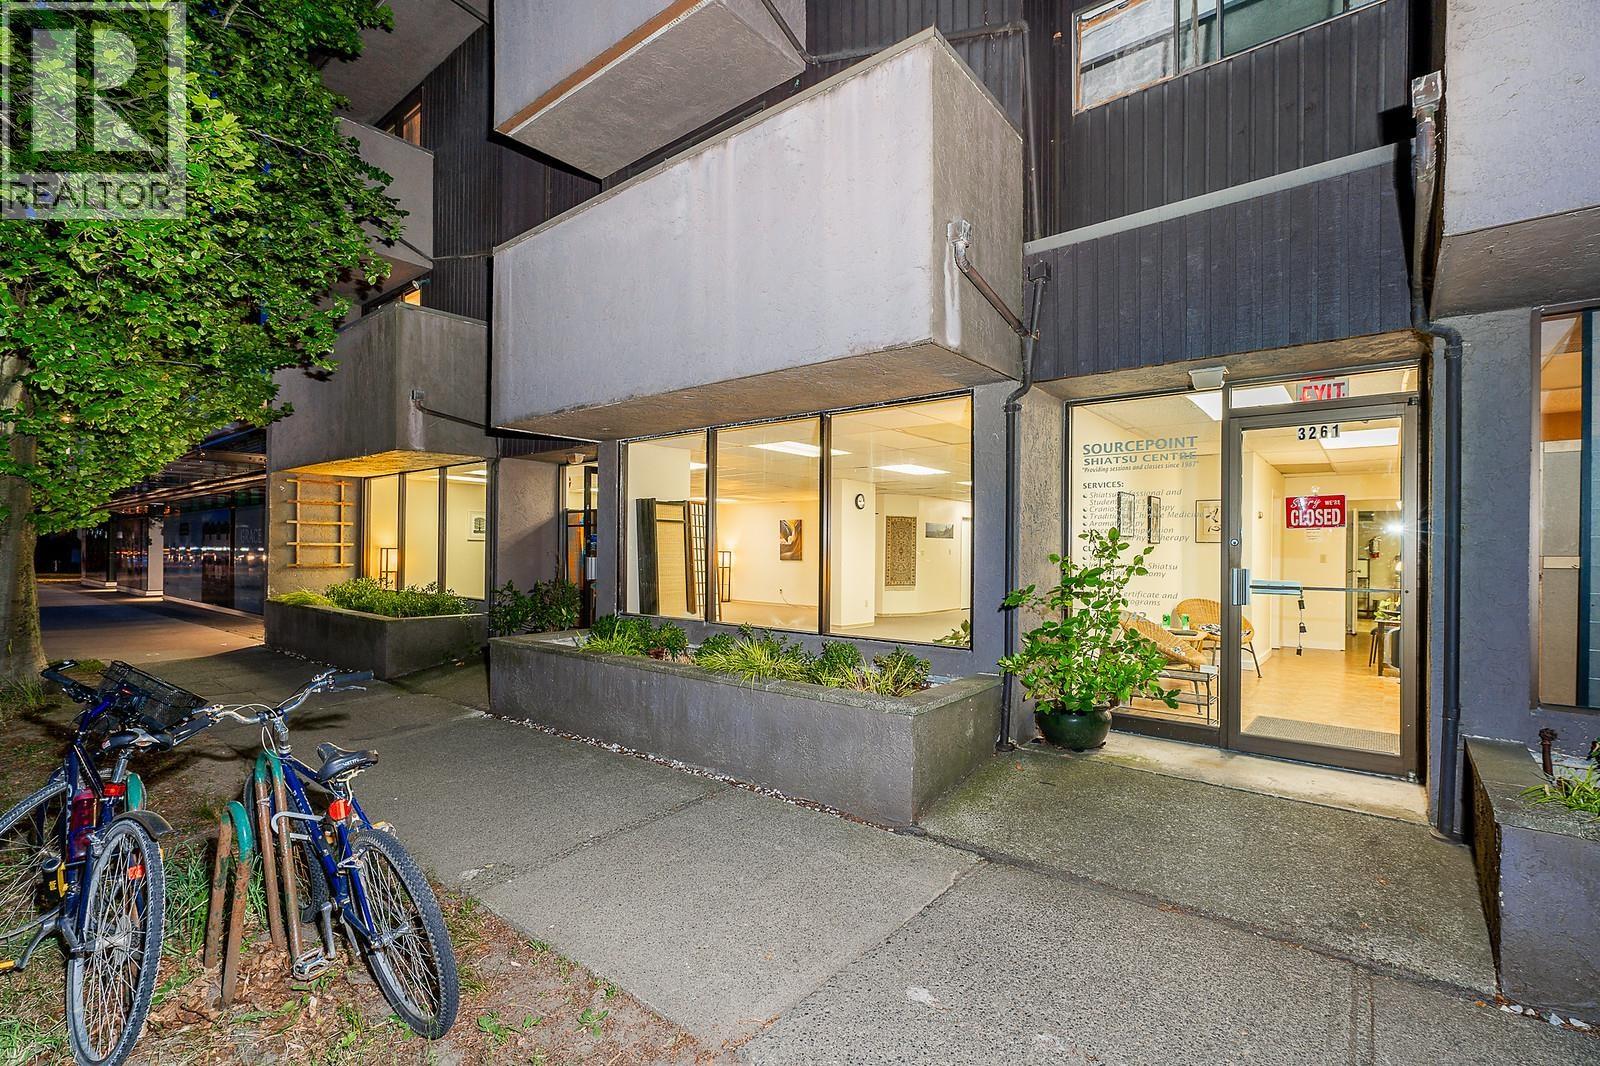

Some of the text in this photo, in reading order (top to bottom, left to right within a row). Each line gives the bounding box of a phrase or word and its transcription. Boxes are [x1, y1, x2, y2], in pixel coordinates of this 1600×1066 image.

[1298, 424, 1340, 440] 3261
[1083, 436, 1199, 455] SOURCEPOINT
[1084, 451, 1197, 466] SHIATSU CENTRE
[1082, 481, 1125, 490] SERVICES:
[1166, 488, 1183, 496] and
[1290, 508, 1341, 526] CLOSED
[1147, 562, 1178, 570] Shiatsu
[1120, 591, 1179, 600] ertificate and
